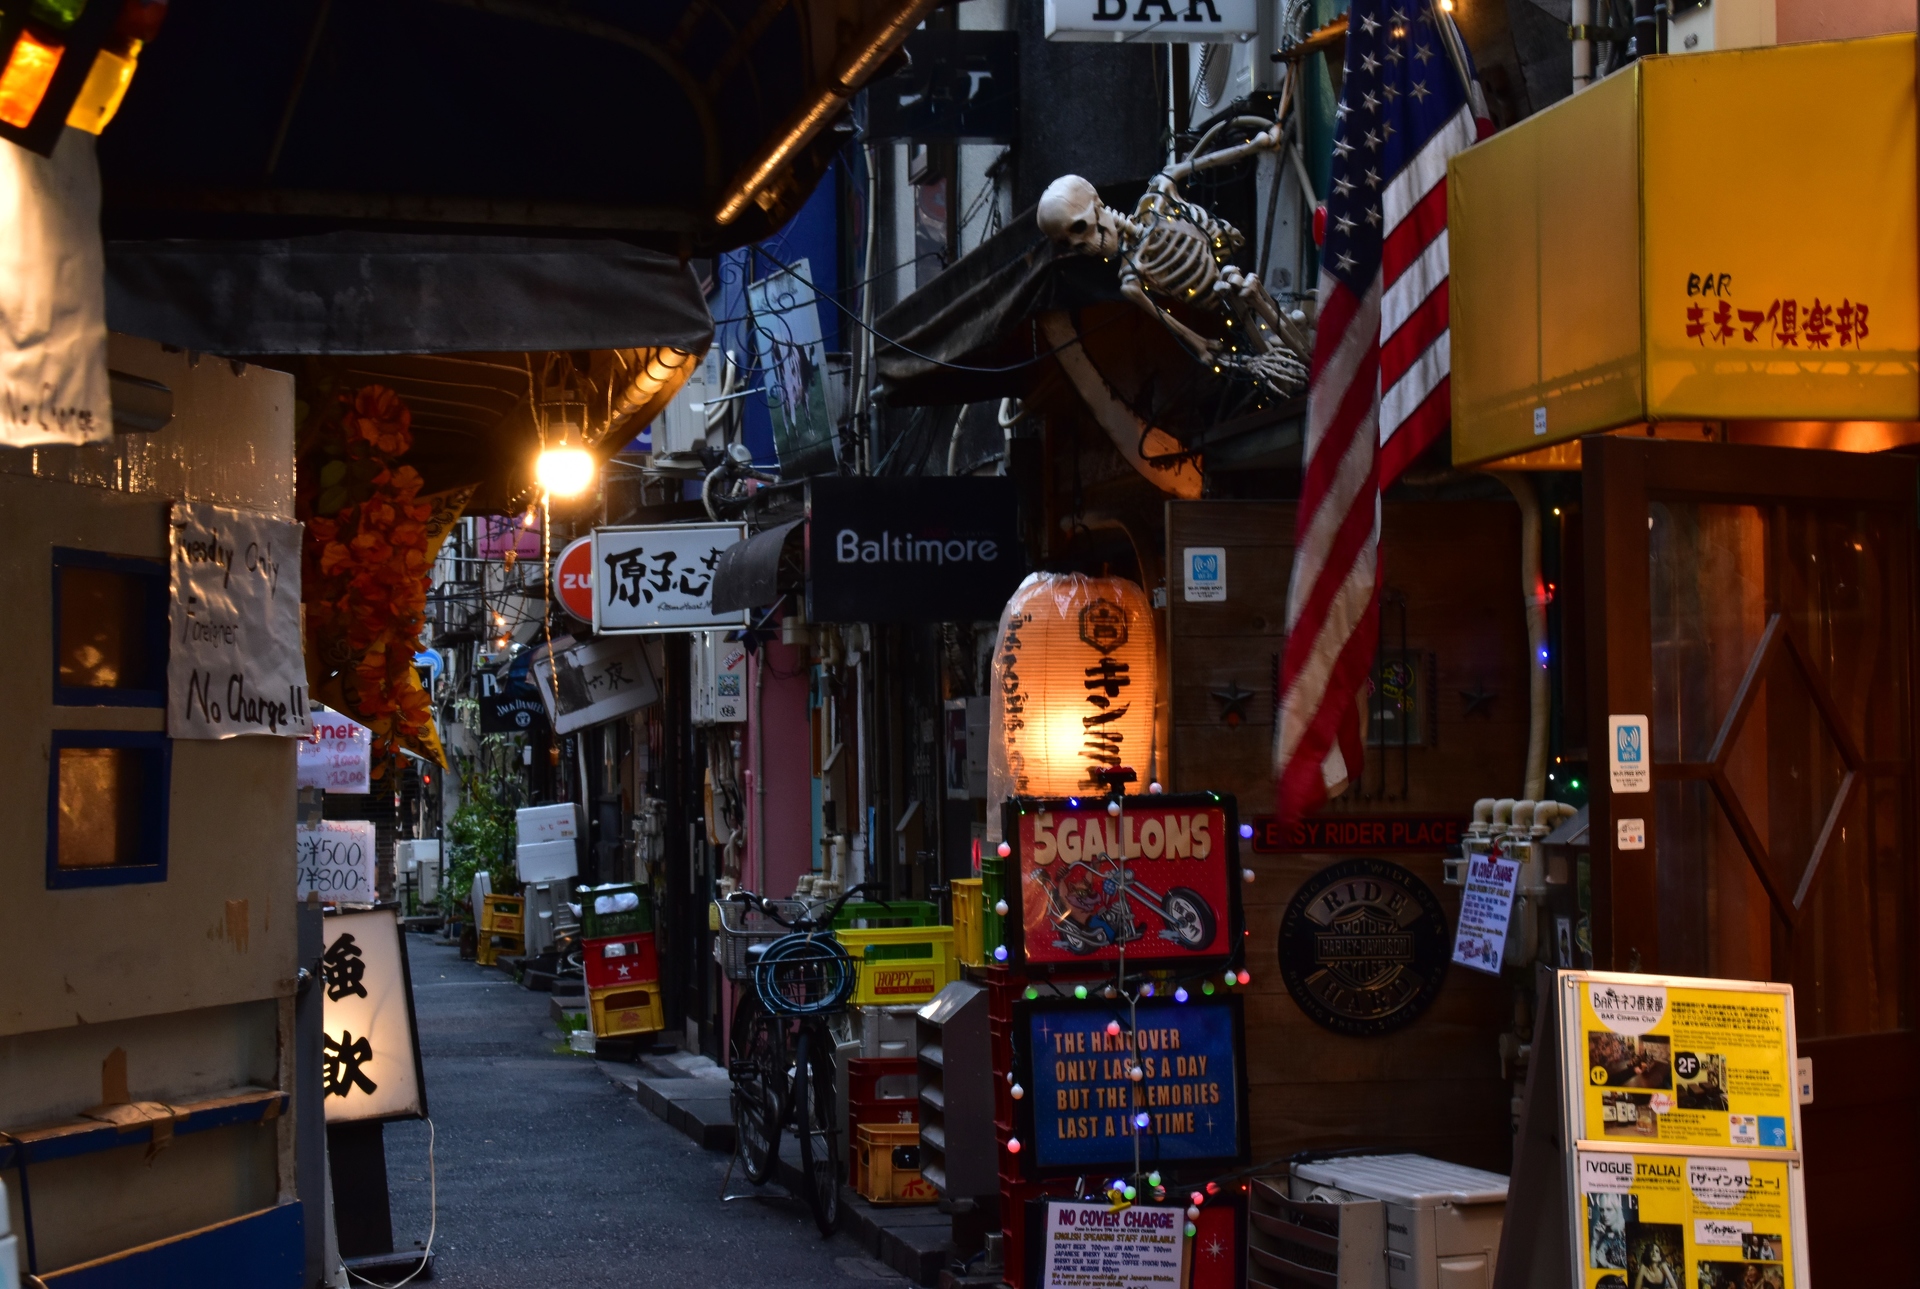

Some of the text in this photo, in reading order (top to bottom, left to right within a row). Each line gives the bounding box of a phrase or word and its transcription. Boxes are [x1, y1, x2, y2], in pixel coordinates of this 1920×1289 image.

[1687, 272, 1732, 298] BAR
[1685, 297, 1870, 350] キネマ倶楽部
[835, 528, 999, 566] Baltimore
[245, 541, 280, 600] Only
[182, 596, 239, 648] Foreigner
[186, 669, 305, 734] No Charge!!
[1266, 822, 1457, 845] ESY RIDER PLACE
[1371, 863, 1411, 887] WIDE
[1322, 881, 1409, 916] RIDE
[1342, 919, 1387, 935] MOTOR
[1322, 938, 1407, 955] HARLEY-DAVIDSON
[877, 971, 913, 986] HOPPY
[1323, 978, 1412, 1015] HARD
[1617, 1014, 1639, 1022] Cinema
[1642, 1015, 1656, 1023] Club
[1054, 1033, 1085, 1053] THE
[1056, 1060, 1097, 1082] ONLY
[1161, 1056, 1171, 1078] A
[1177, 1055, 1207, 1077] DAY
[1593, 1071, 1604, 1080] 1F
[1678, 1057, 1696, 1073] 2F
[1057, 1088, 1089, 1110] BUT
[1096, 1087, 1127, 1108] THE
[1058, 1116, 1098, 1139] LAST
[1105, 1115, 1115, 1136] A
[1059, 1210, 1174, 1229] NO COVER CHARGE
[1054, 1232, 1081, 1241] ENGLISH
